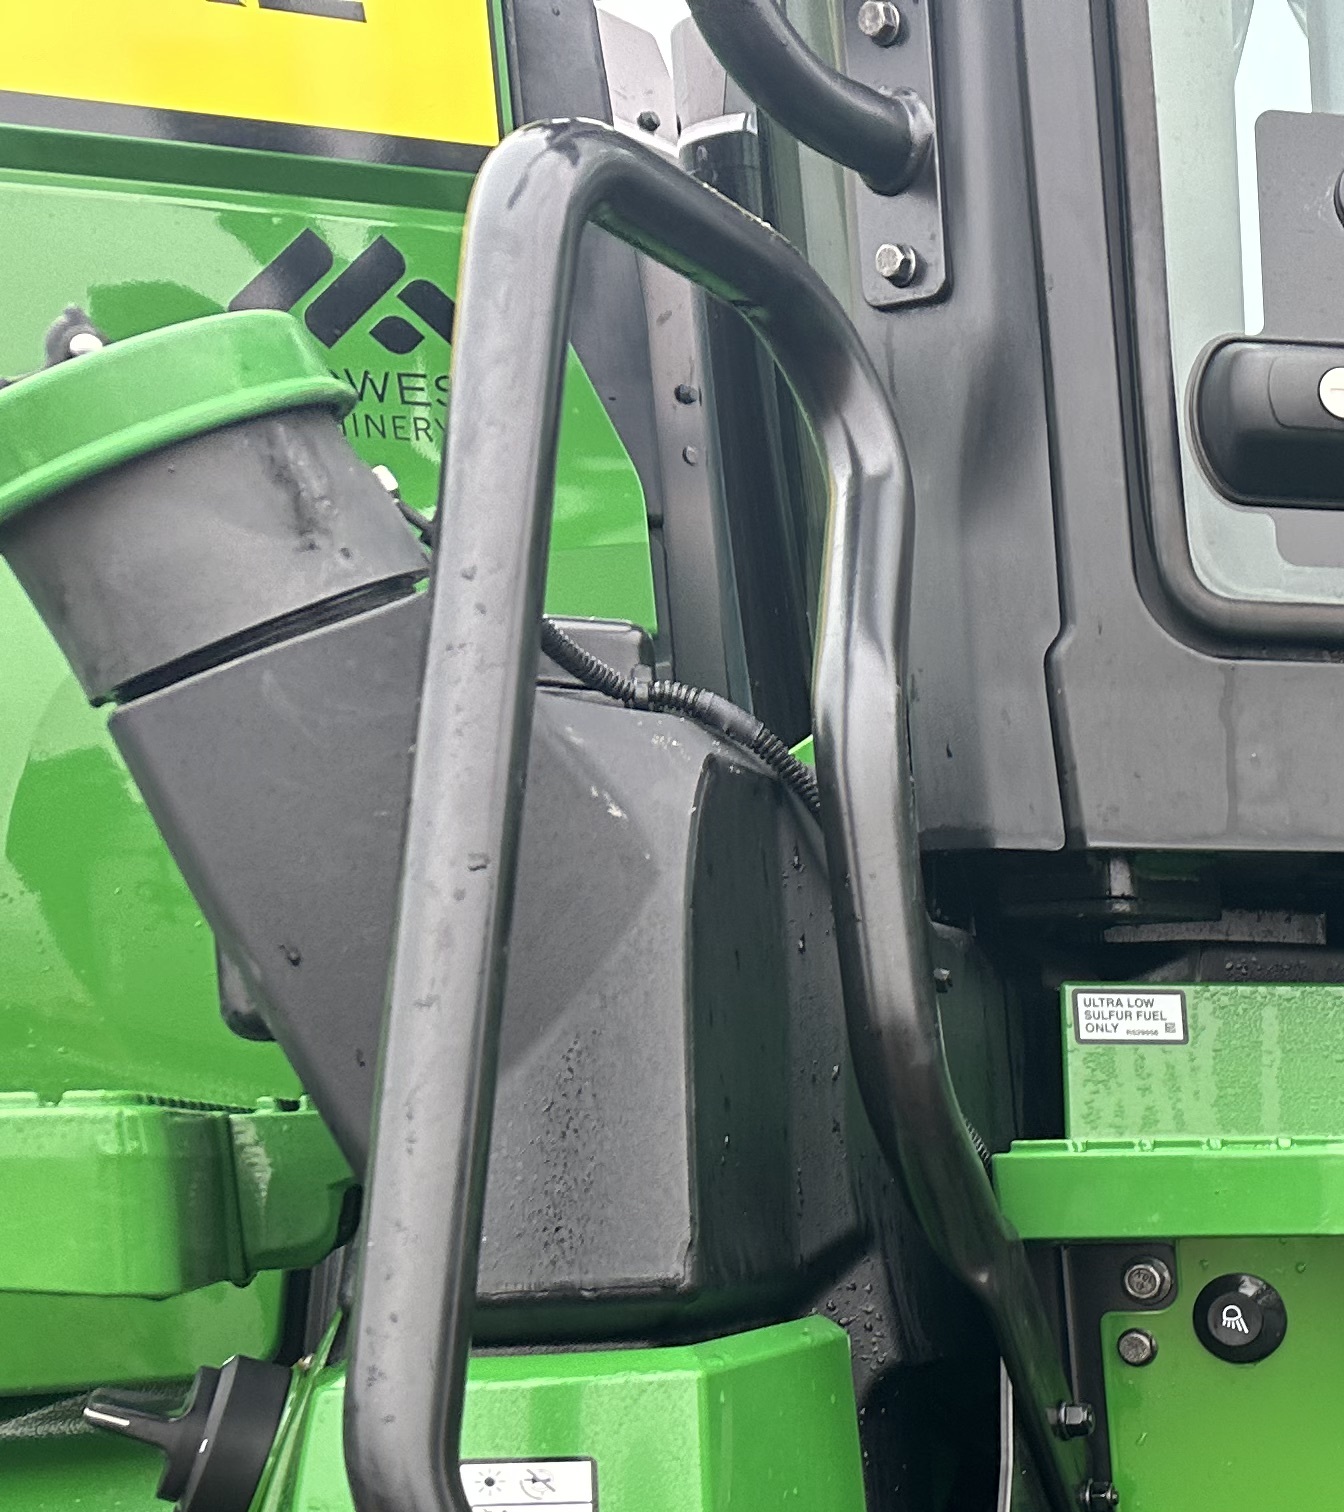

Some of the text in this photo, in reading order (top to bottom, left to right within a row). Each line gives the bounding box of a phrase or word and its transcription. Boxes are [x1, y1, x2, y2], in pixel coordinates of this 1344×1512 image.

[1083, 997, 1155, 1008] ULTRA LOW
[1084, 1010, 1167, 1021] SULFUR FUEL
[1085, 1023, 1119, 1033] ONLY
